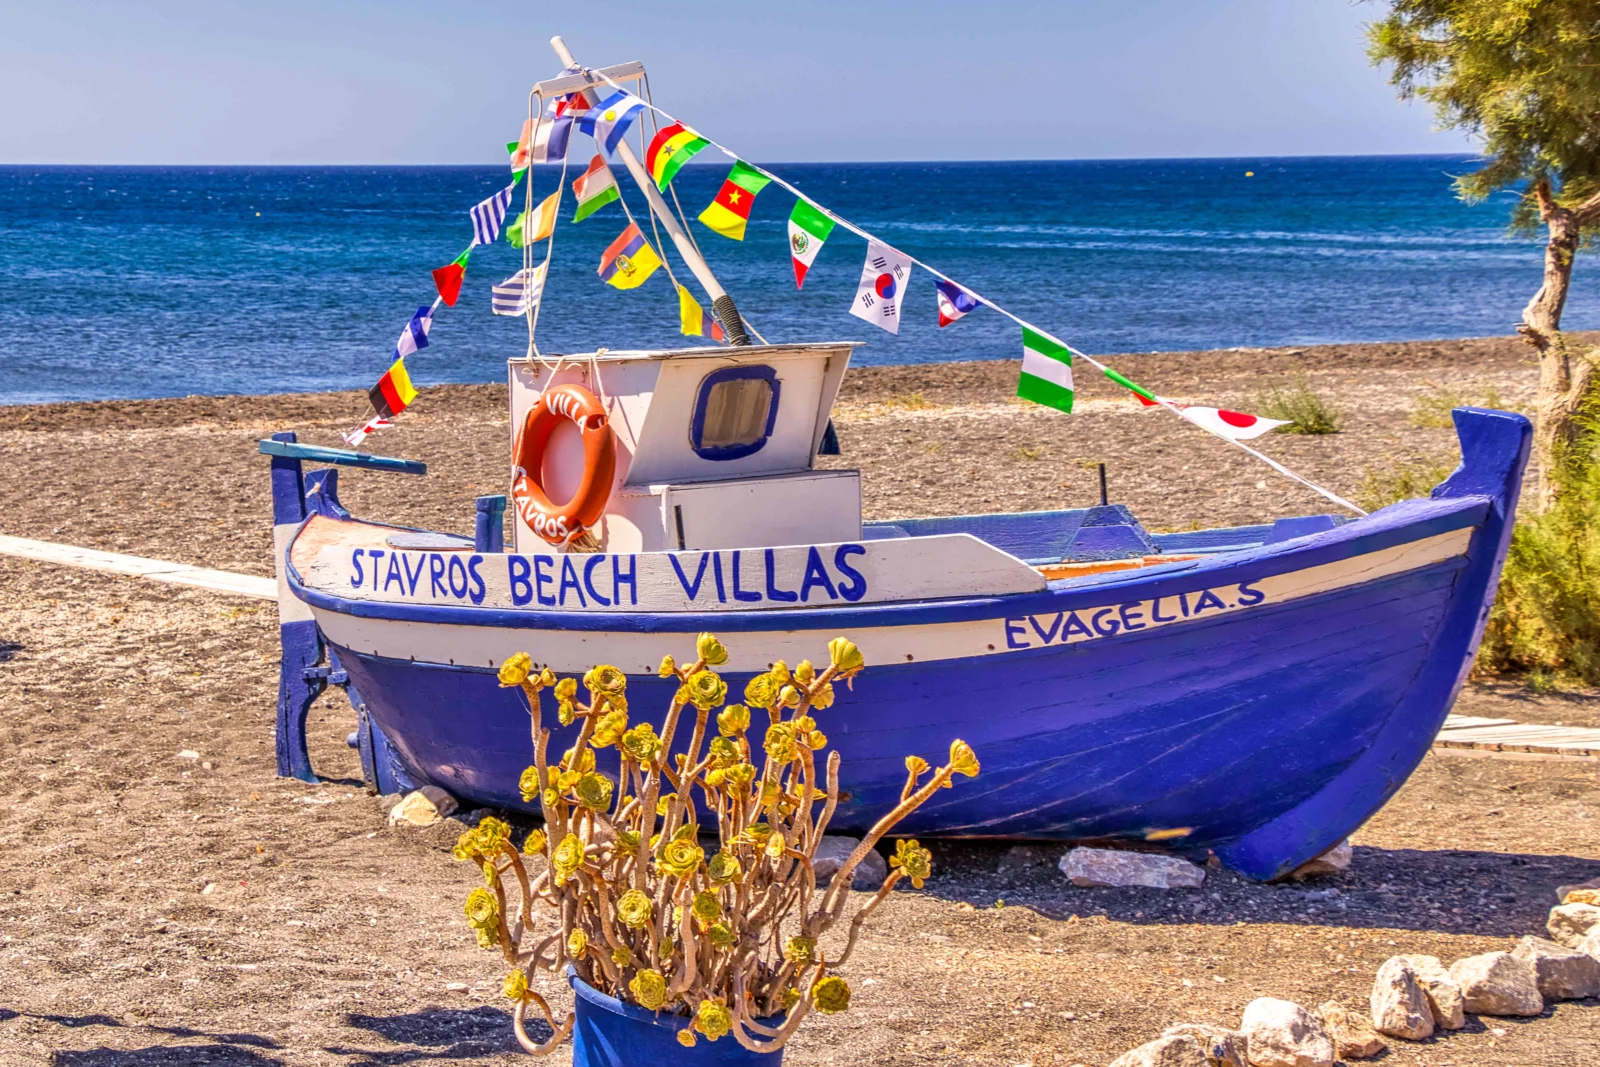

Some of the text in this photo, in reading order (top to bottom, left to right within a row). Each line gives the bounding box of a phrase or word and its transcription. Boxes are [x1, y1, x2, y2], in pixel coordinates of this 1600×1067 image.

[546, 393, 588, 435] VILLA
[351, 545, 867, 606] STAVROS BEACH VILLAS
[1005, 580, 1265, 649] EVAGELIA.S
